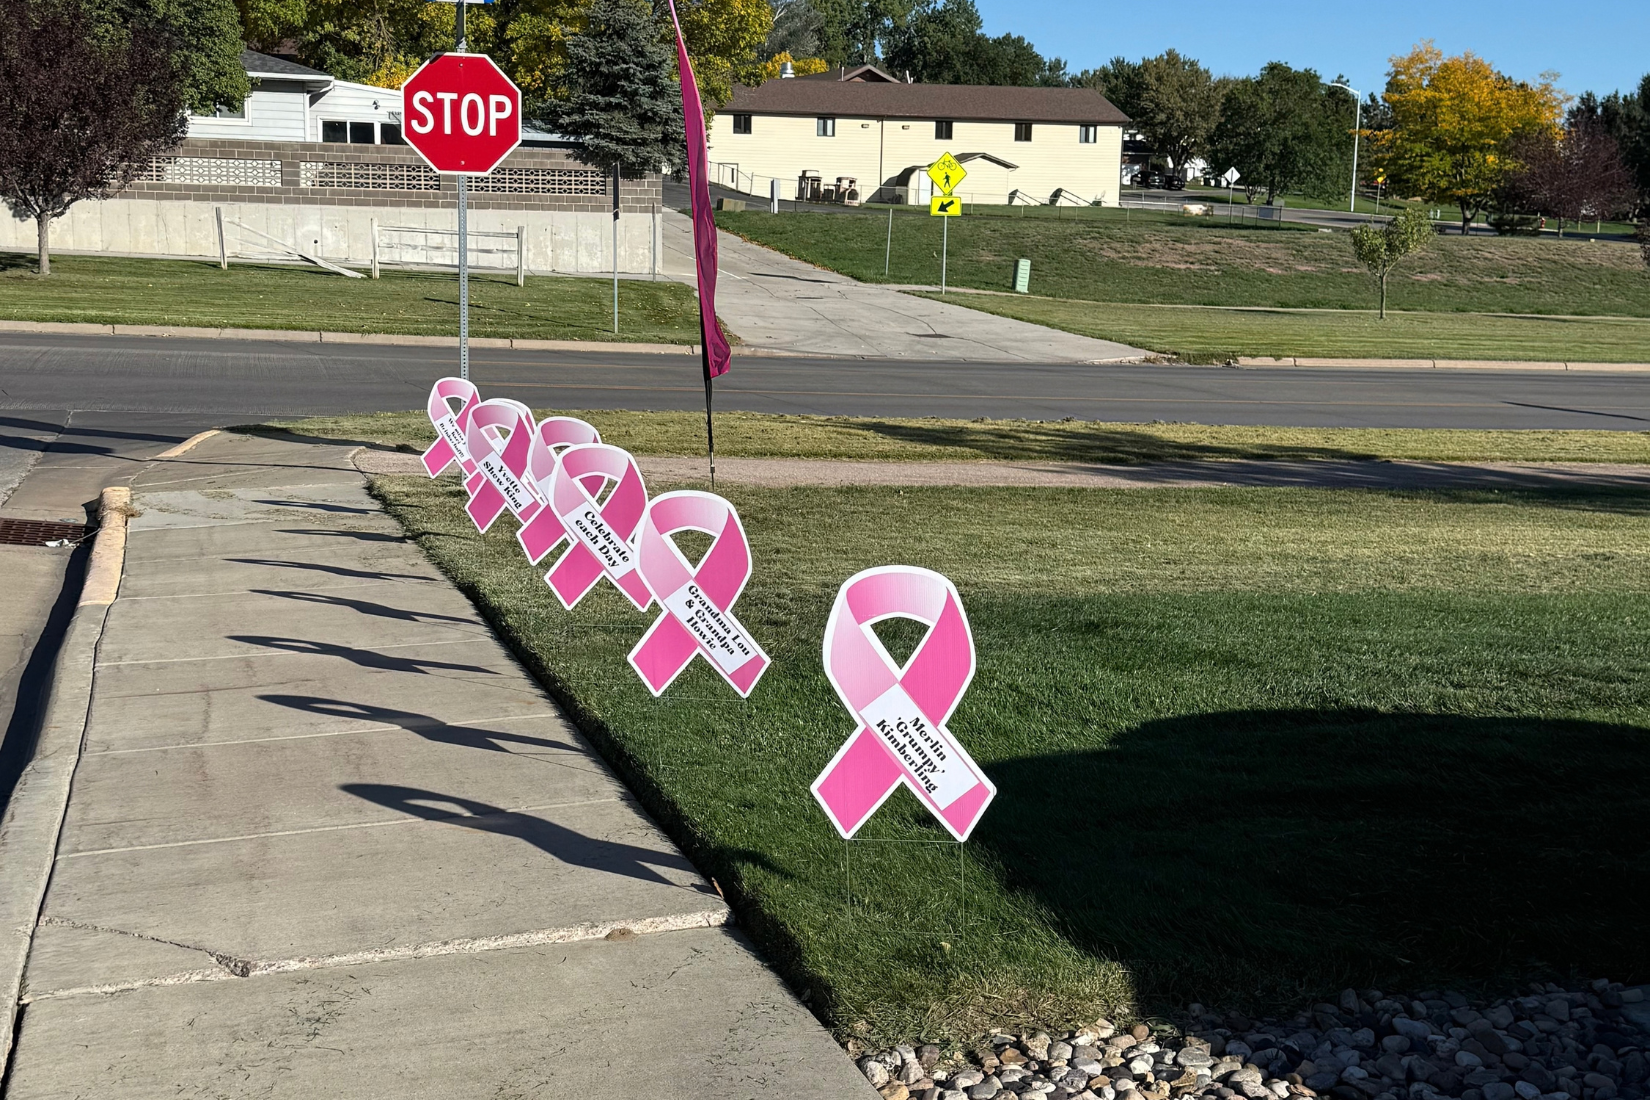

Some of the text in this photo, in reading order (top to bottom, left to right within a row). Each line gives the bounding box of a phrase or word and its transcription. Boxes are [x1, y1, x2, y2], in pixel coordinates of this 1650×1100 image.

[411, 90, 512, 136] STOP
[498, 465, 520, 493] Yvette
[504, 486, 522, 509] King
[575, 519, 620, 567] each Day
[584, 511, 630, 562] Celebrate
[685, 599, 735, 655] & Grandpa
[686, 616, 716, 650] Howie
[688, 585, 750, 656] Grandma Lou
[876, 719, 938, 794] Kimberling
[909, 716, 947, 761] Merlin
